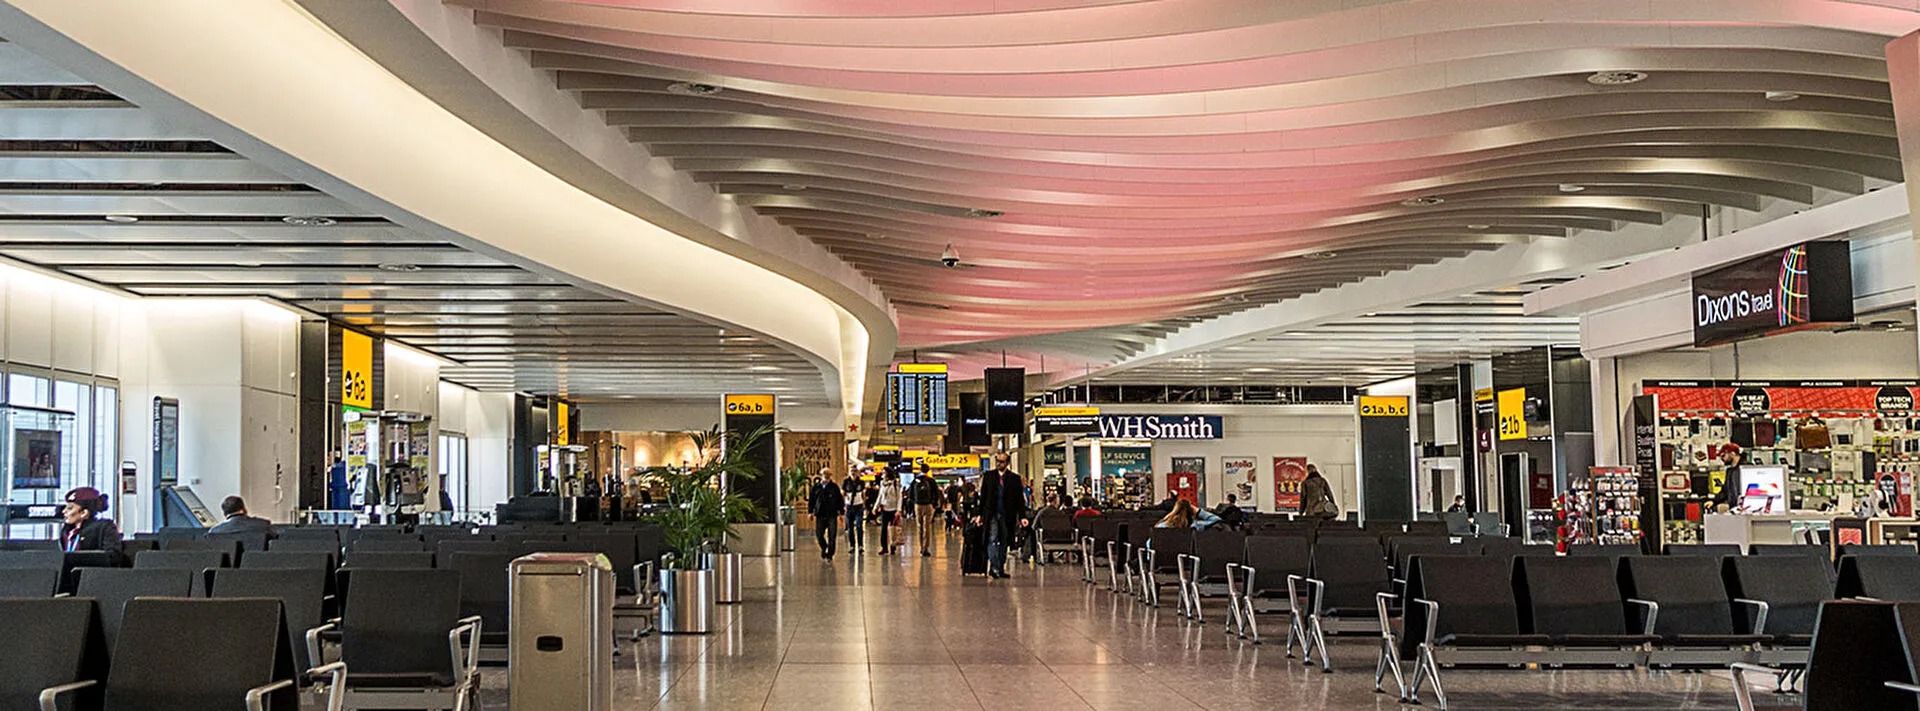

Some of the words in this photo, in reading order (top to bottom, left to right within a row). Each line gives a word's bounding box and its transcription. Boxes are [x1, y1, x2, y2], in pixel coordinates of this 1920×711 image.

[1698, 290, 1750, 326] Dixons
[1751, 288, 1773, 313] travel
[354, 371, 366, 401] 6a
[1099, 416, 1214, 439] WHSmith
[1508, 414, 1519, 434] 1b
